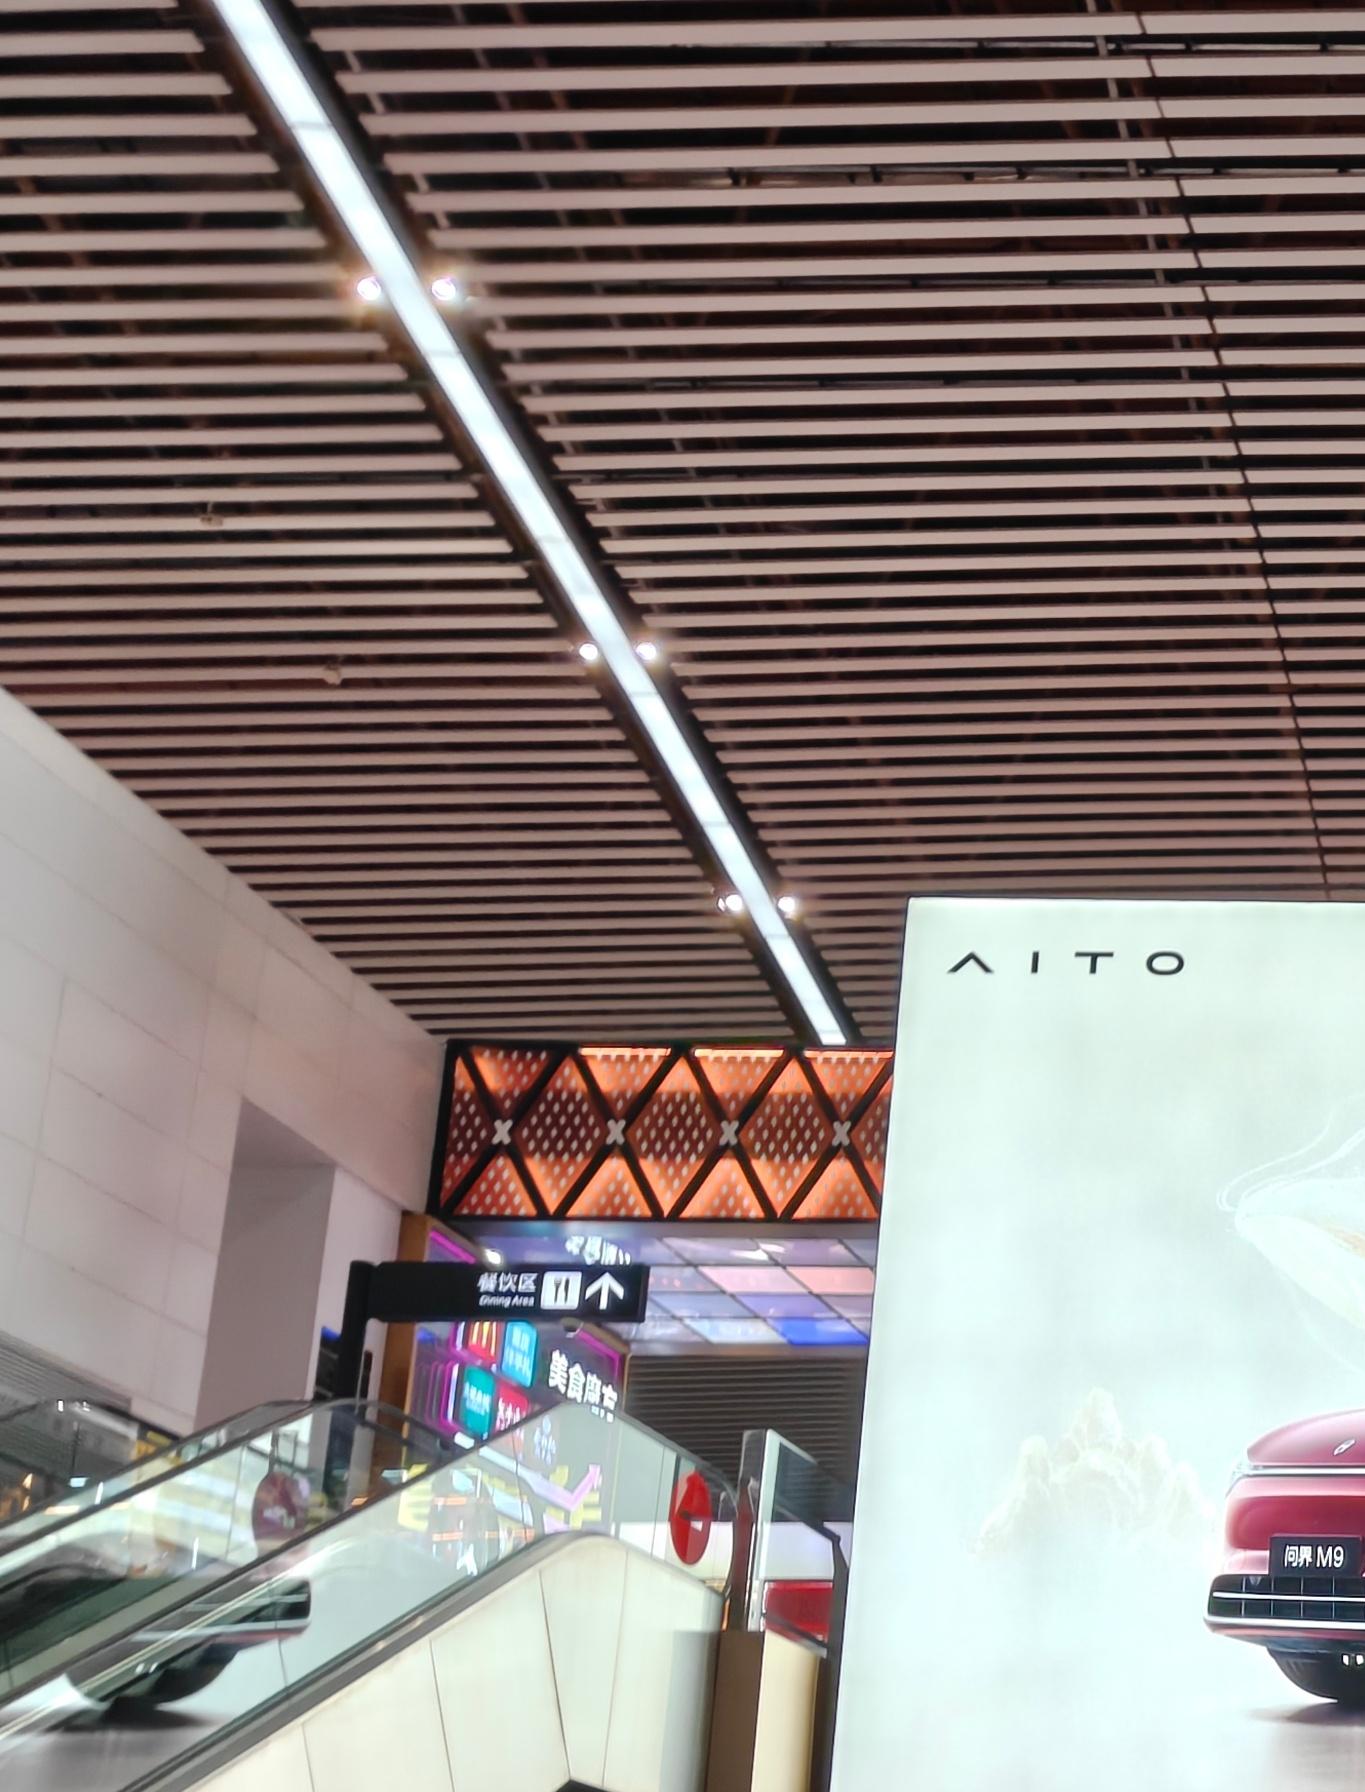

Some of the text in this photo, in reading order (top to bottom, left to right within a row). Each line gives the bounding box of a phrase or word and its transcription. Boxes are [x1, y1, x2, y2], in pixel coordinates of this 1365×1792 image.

[947, 950, 1185, 976] AITO
[477, 1271, 538, 1294] 餐饮区
[512, 1294, 535, 1307] Area
[1284, 1545, 1345, 1568] 问界 M9
